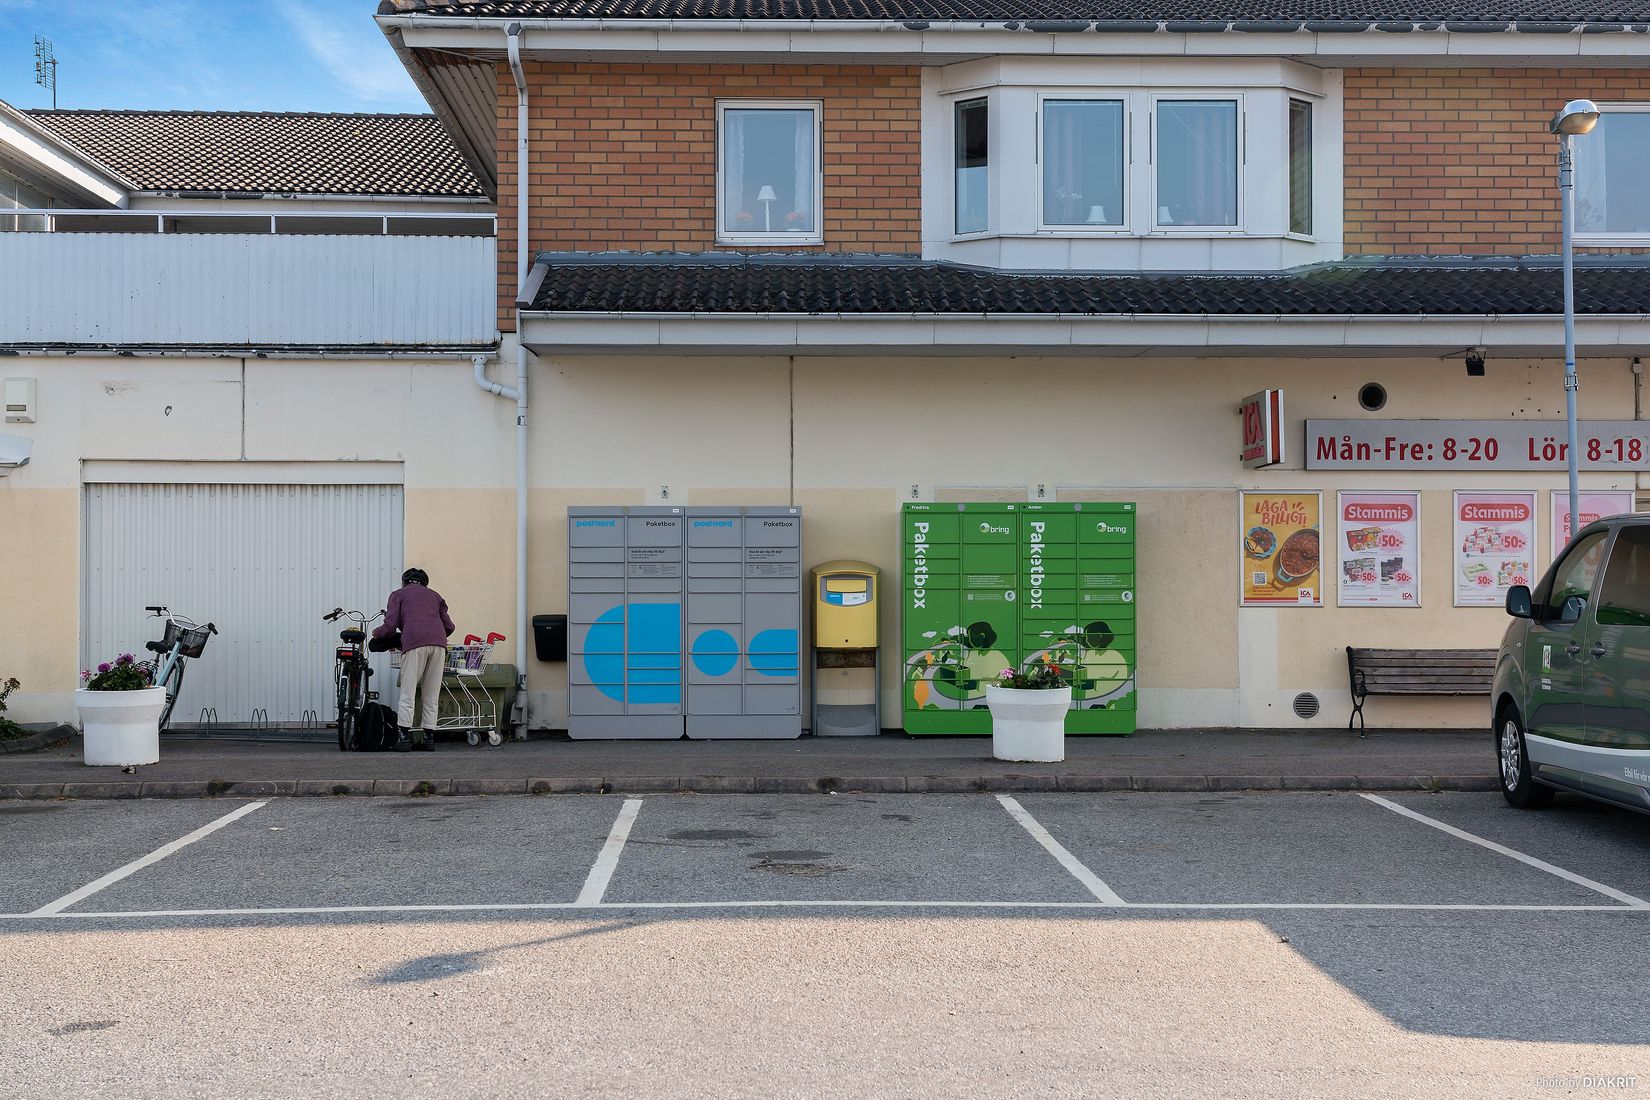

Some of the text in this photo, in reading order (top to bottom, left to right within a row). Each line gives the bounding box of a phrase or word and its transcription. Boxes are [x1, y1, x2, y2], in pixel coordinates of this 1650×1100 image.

[1243, 401, 1264, 446] ICA
[1316, 435, 1434, 461] Mån-Fre:
[1442, 437, 1499, 461] 8-20
[1587, 438, 1643, 462] 8-18
[1255, 500, 1288, 514] LAGA
[1348, 505, 1409, 519] Stammis
[1464, 506, 1525, 519] Stammis
[1261, 511, 1307, 528] BILLIGT!
[990, 525, 1010, 535] bring
[1107, 525, 1127, 535] bring
[1381, 535, 1403, 547] 50:-
[1503, 536, 1526, 548] 50:-
[914, 522, 929, 609] Paketbox
[1030, 522, 1046, 609] Paketbox
[1362, 573, 1376, 581] 50:-
[1397, 573, 1411, 581] 50:-
[1478, 576, 1492, 584] 50:-
[1513, 576, 1528, 584] 50:-
